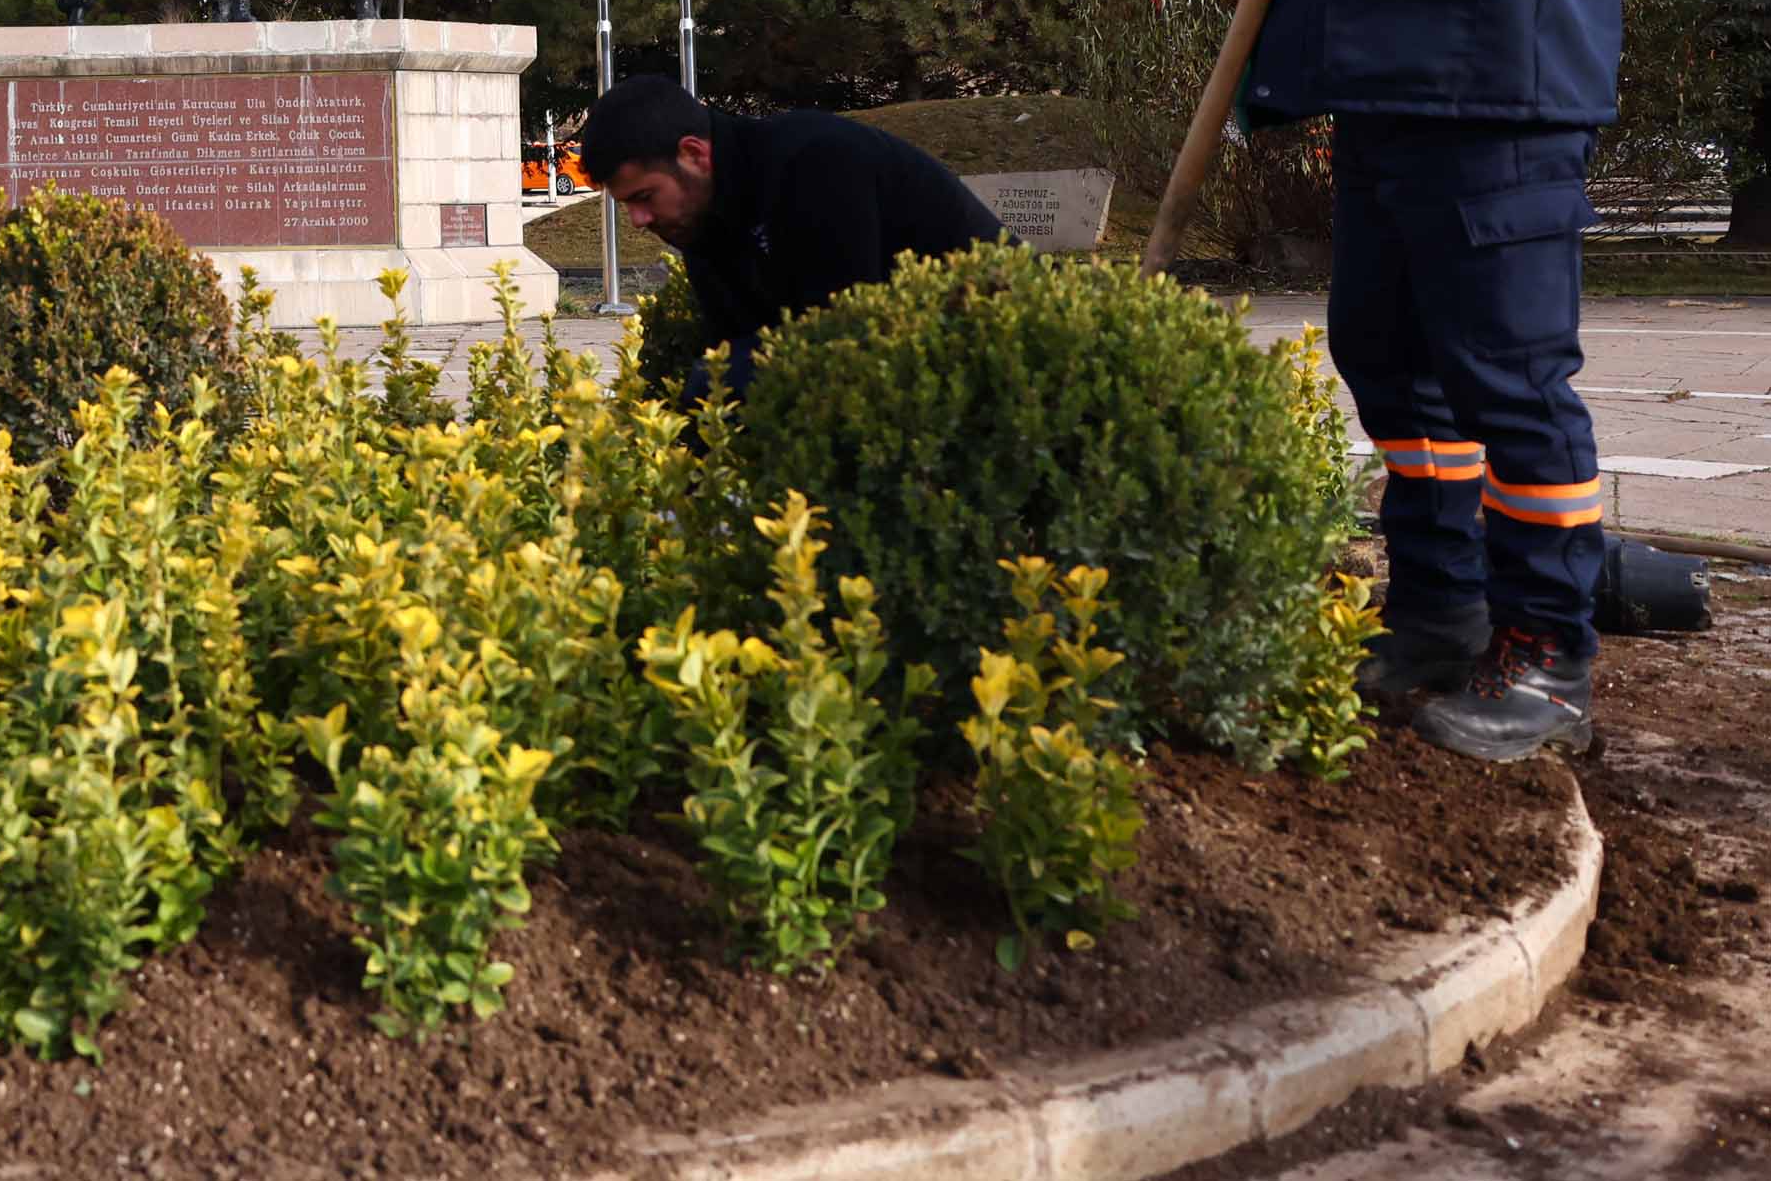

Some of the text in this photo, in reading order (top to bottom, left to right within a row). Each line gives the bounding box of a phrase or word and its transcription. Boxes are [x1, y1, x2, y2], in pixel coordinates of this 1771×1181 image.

[30, 100, 73, 115] Türkiye
[182, 98, 237, 110] Kurucusu
[246, 98, 266, 109] Ulu
[276, 94, 310, 108] Önder
[50, 117, 97, 131] Kongresi
[103, 116, 139, 128] Temsil
[148, 115, 184, 129] Heyeti
[192, 113, 232, 128] Üyeleri
[239, 116, 252, 125] ve
[261, 114, 290, 125] Silah
[10, 133, 22, 146] 27
[30, 133, 65, 145] Aralık
[71, 133, 98, 145] 1919
[105, 131, 162, 144] Cumartesi
[171, 130, 199, 142] Günü
[208, 130, 242, 142] Kadın
[288, 129, 321, 144] Çoluk
[64, 149, 113, 161] Ankaralı
[125, 147, 189, 160] Tarafından
[196, 146, 242, 158] Dikmen
[250, 146, 315, 158] Sırtlarında
[10, 168, 81, 181] Alaylarının
[90, 166, 140, 179] Coşkulu
[149, 164, 237, 178] Gösterileriyle
[91, 184, 126, 198] Büyük
[135, 182, 171, 195] Önder
[174, 183, 216, 194] Atatürk
[225, 186, 238, 194] ve
[246, 181, 276, 193] Silah
[283, 181, 367, 195] Arkadaşlarının
[224, 198, 272, 210] Olarak
[283, 216, 369, 227] 27 Aralık 2000
[1001, 212, 1054, 224] ERZURUM
